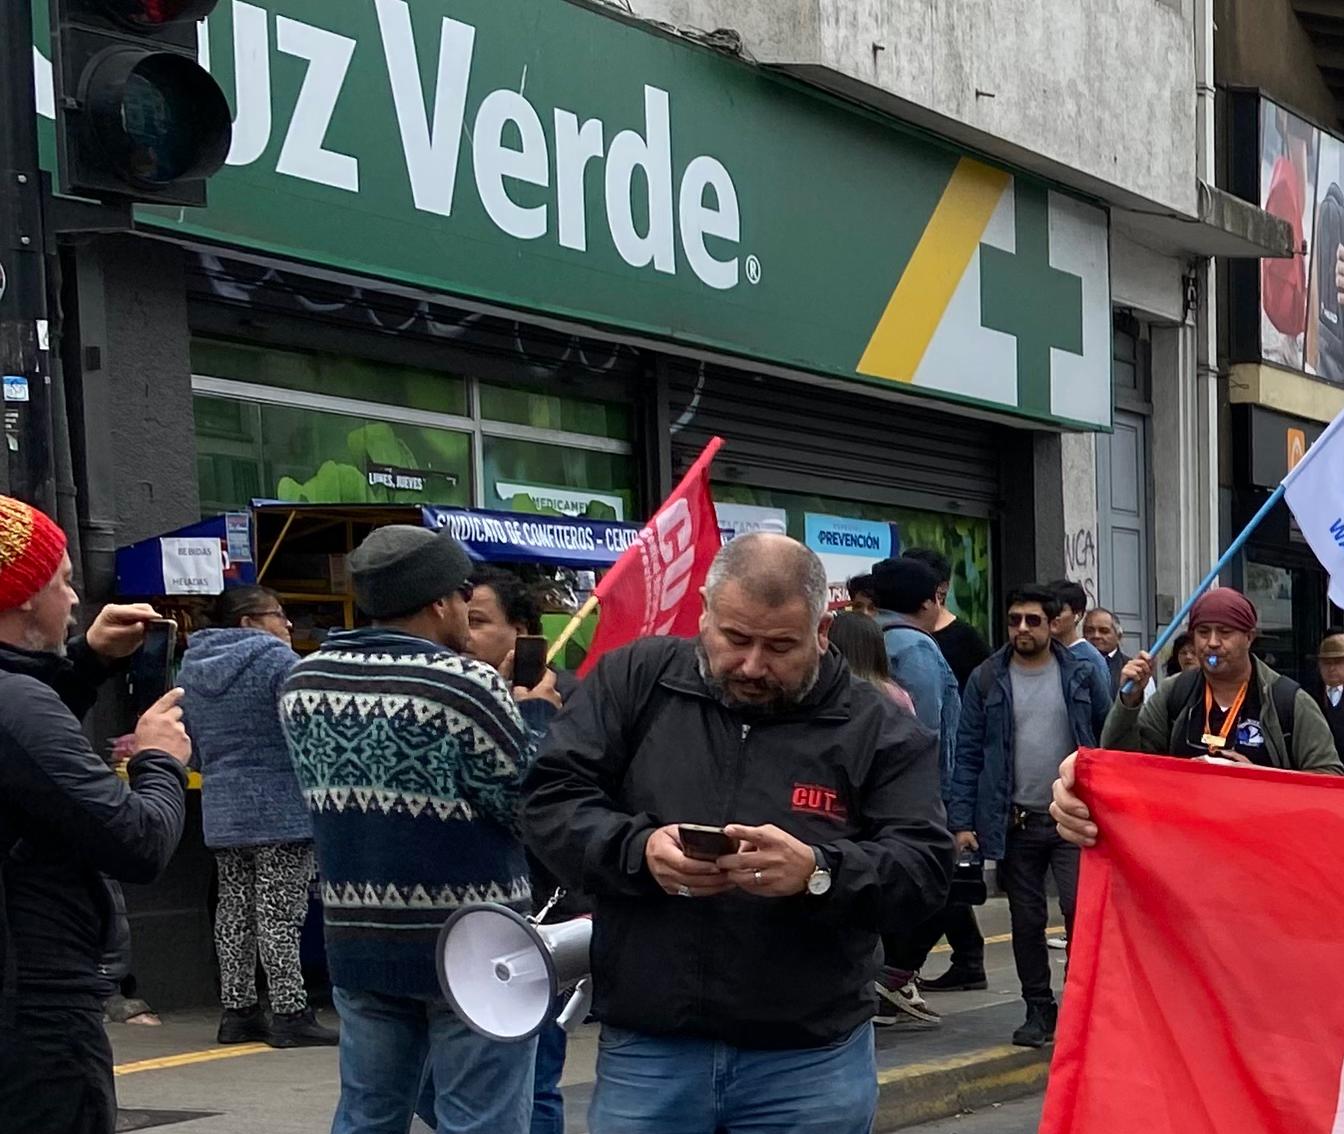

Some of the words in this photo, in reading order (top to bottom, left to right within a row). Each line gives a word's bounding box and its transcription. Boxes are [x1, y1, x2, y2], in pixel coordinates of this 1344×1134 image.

[375, 0, 740, 290] Verde
[605, 527, 640, 552] CENTR
[820, 531, 881, 550] PREVENCIÓN
[792, 787, 837, 811] CUT
